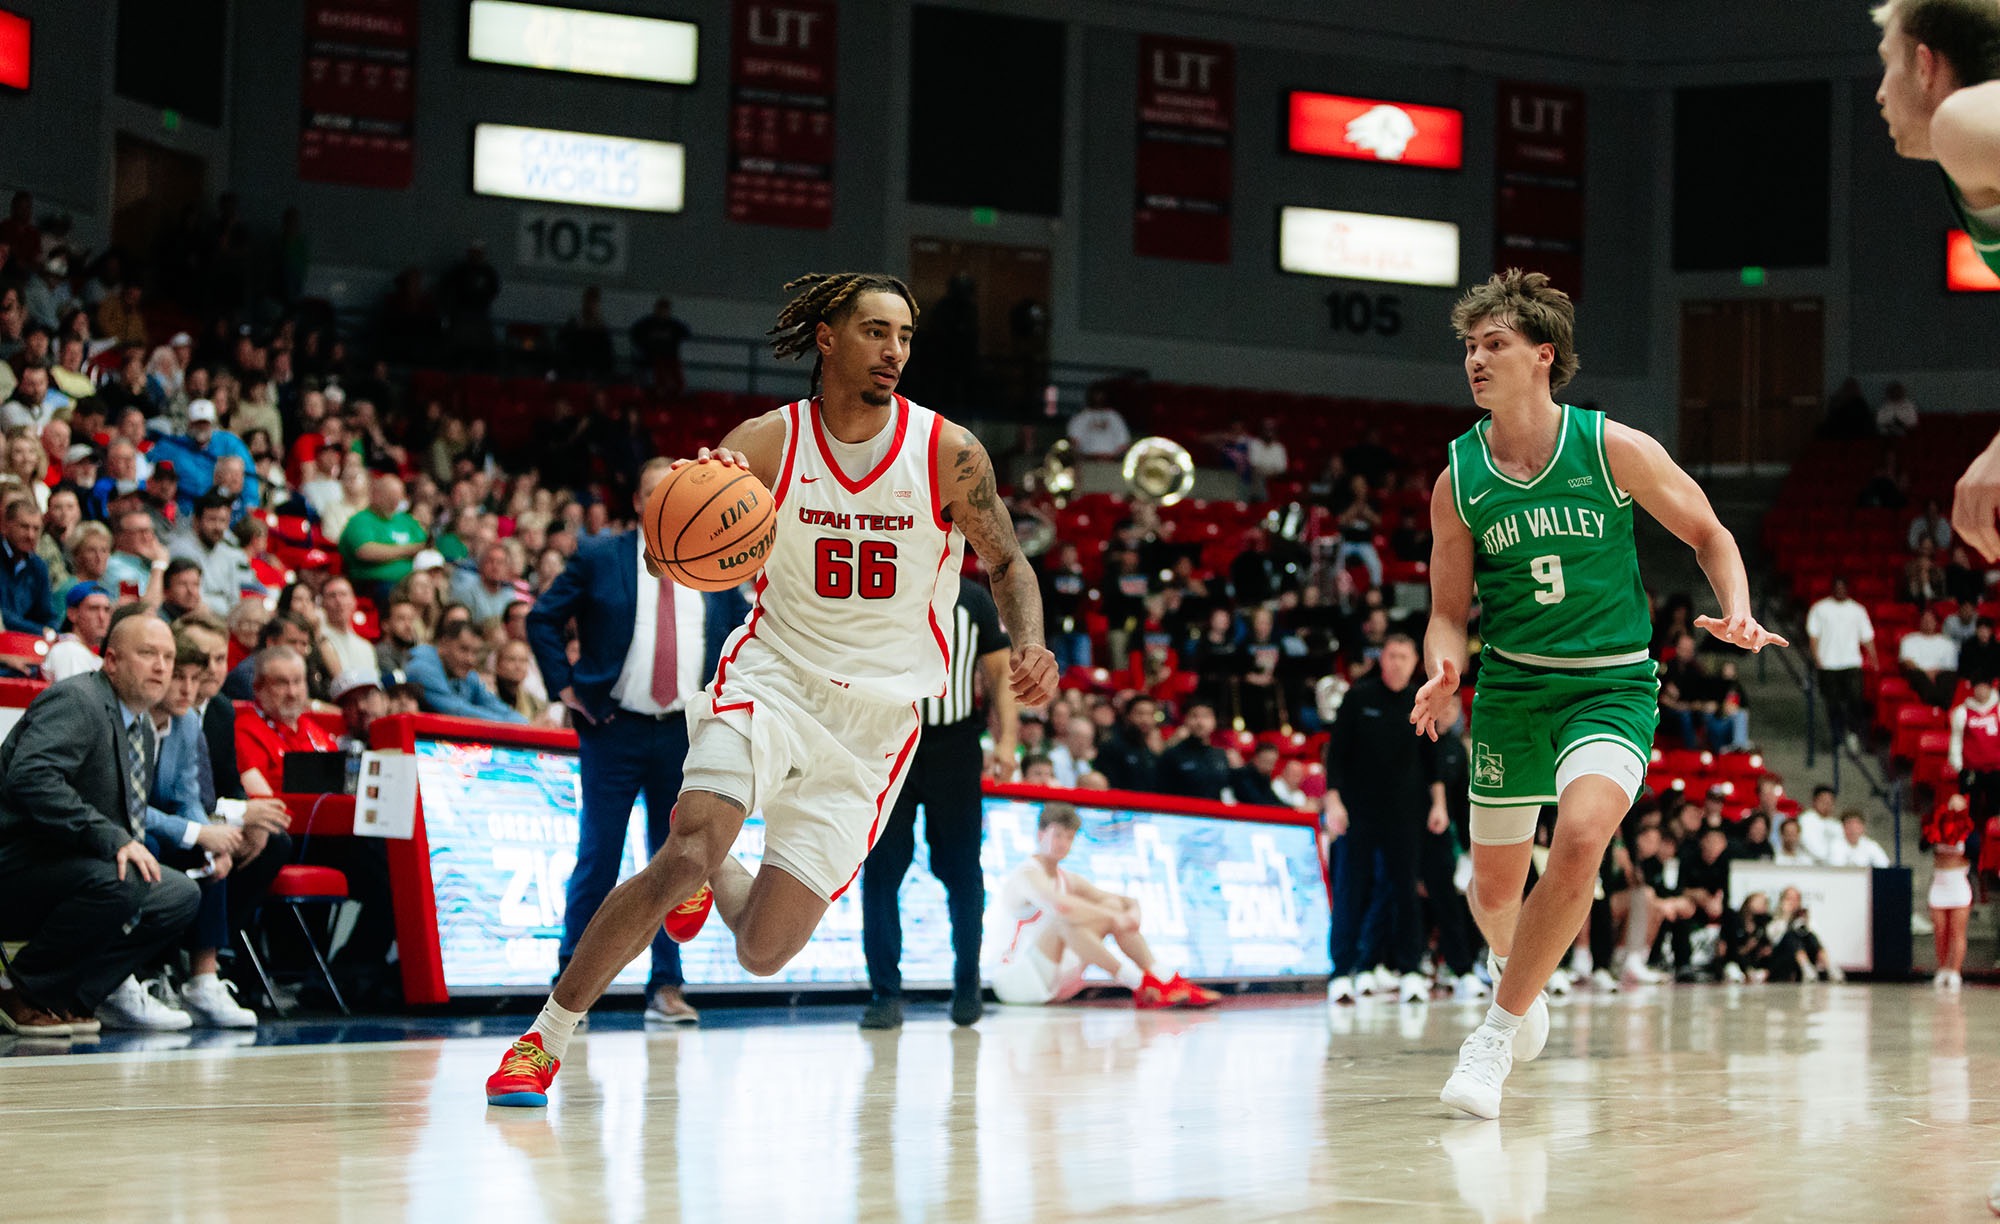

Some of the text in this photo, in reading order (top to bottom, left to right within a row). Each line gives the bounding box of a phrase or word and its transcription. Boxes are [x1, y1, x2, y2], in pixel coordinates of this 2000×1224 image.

[747, 6, 823, 48] UT
[1152, 49, 1222, 92] UT
[1510, 97, 1574, 136] UT
[524, 161, 641, 198] WORLD
[528, 218, 616, 265] 105
[1324, 290, 1402, 336] 105
[1567, 476, 1593, 488] WAC
[799, 506, 914, 531] UTAH TECH
[1524, 506, 1605, 540] VALLEY
[815, 537, 898, 600] 66
[1529, 554, 1567, 606] 9
